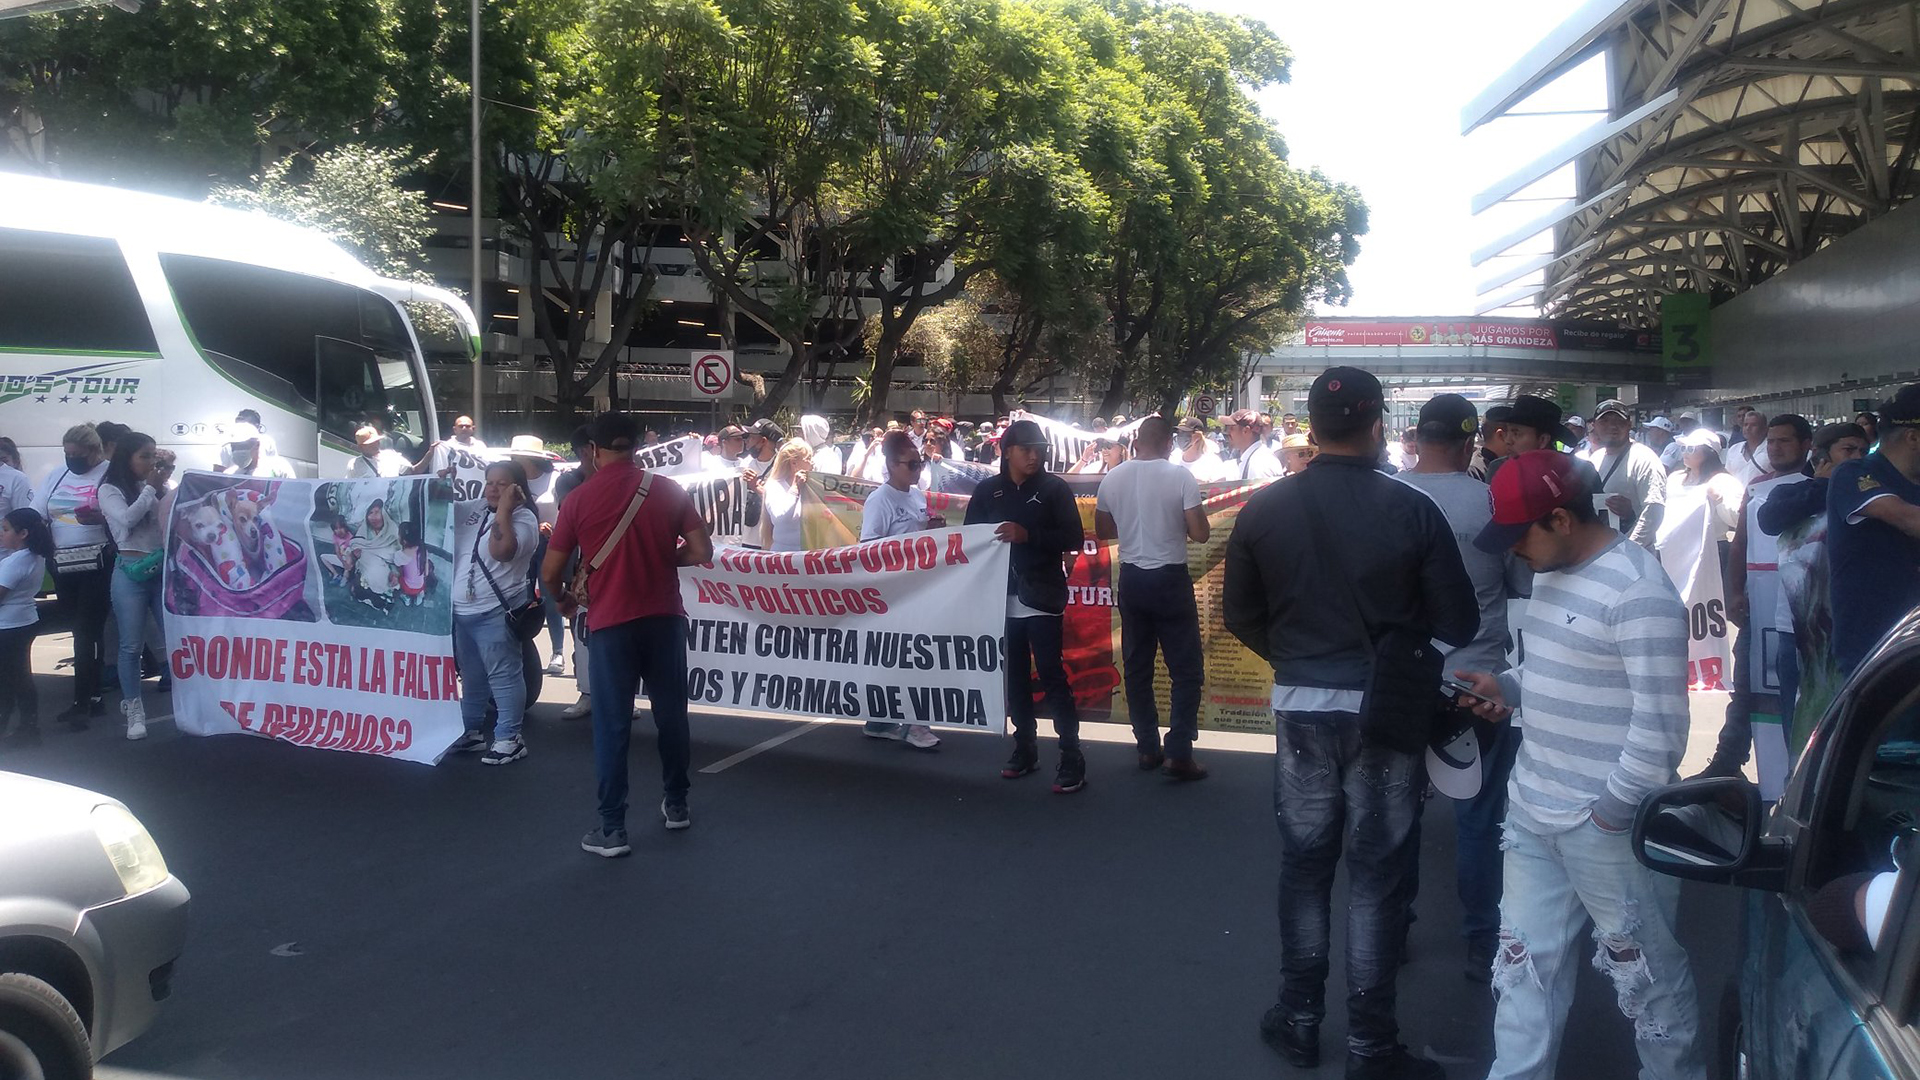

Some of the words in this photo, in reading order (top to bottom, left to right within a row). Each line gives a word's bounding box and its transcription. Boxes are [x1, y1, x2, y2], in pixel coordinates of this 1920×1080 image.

[1308, 326, 1345, 337] Caliente
[1475, 326, 1526, 336] JUGAMOS
[1529, 328, 1550, 336] POR
[1563, 329, 1589, 337] Recibe
[1472, 333, 1493, 343] MÁS
[1497, 336, 1554, 347] GRANDEZA
[1671, 324, 1700, 362] 3
[66, 376, 141, 394] TOUR
[1562, 396, 1572, 409] 5
[1639, 410, 1648, 421] 3
[720, 547, 799, 576] TOTAL
[804, 537, 938, 576] REPUDIO
[944, 533, 970, 566] A
[692, 577, 739, 605] LOS
[735, 582, 889, 616] POLÍTICOS
[754, 624, 858, 665] CONTRA
[172, 635, 288, 682] ¿DONDE
[293, 641, 353, 690] ESTA
[359, 647, 387, 694] LA
[393, 651, 460, 702] FALTA
[731, 671, 748, 705] Y
[751, 673, 861, 718] FORMAS
[865, 684, 906, 720] DE
[908, 687, 989, 726] VIDA
[1218, 708, 1267, 718] Tradición
[259, 703, 412, 756] DERECHOS?
[1235, 718, 1272, 726] genera
